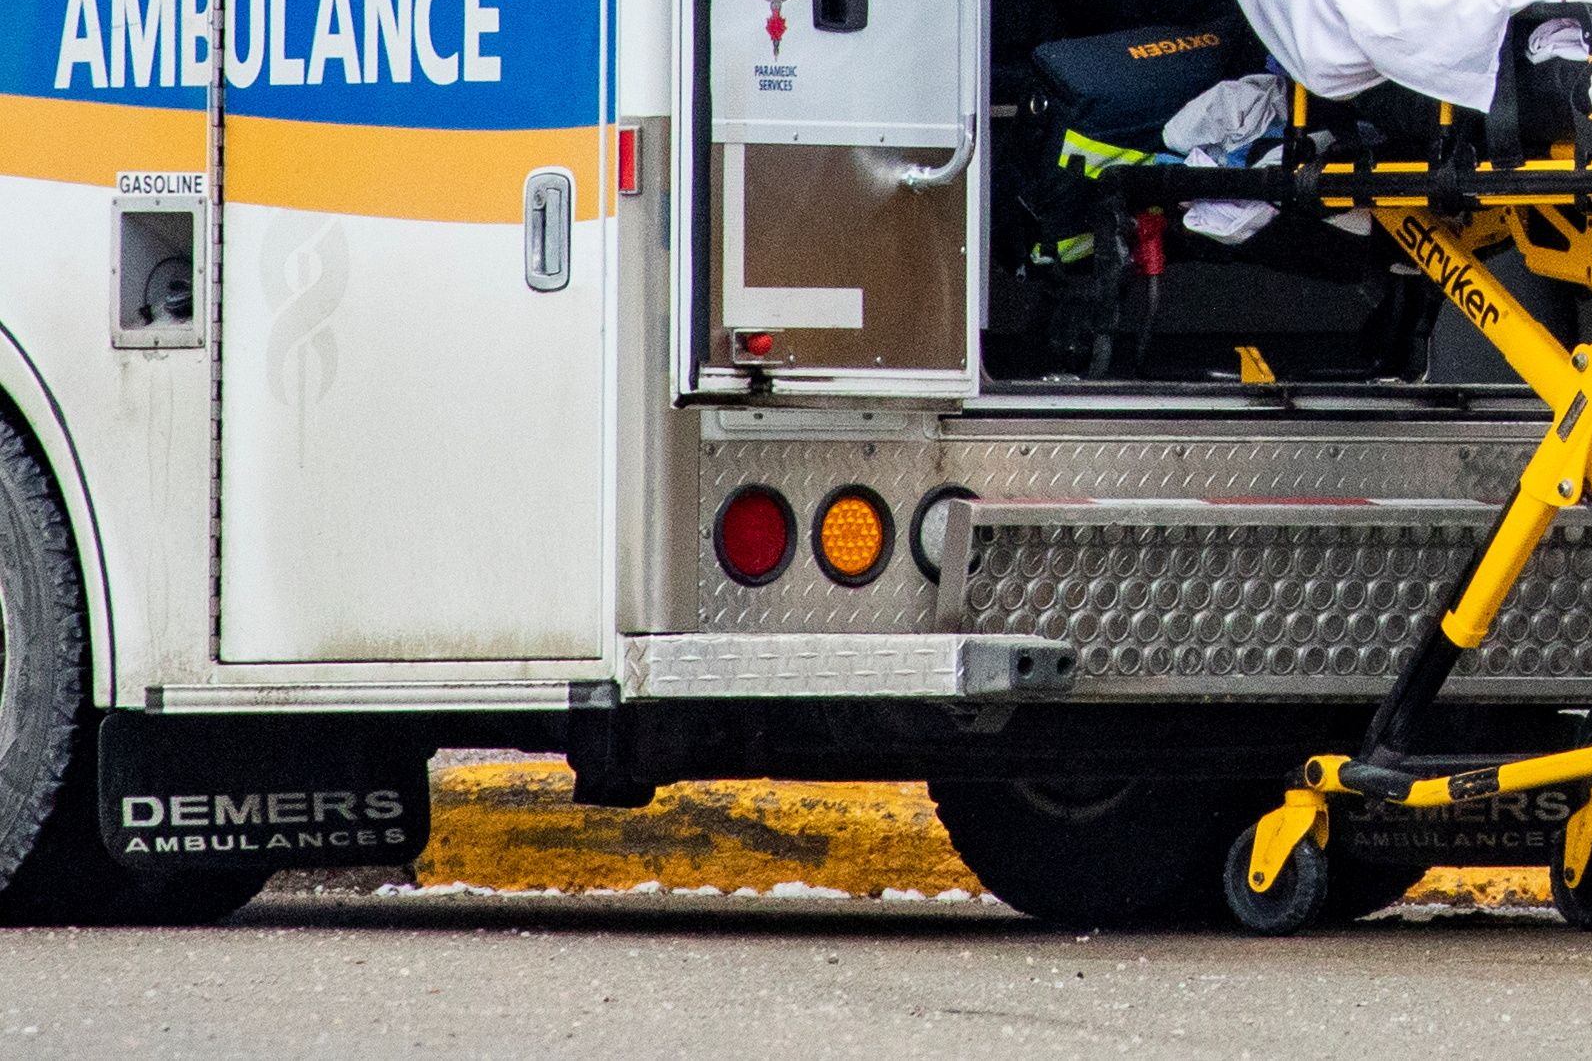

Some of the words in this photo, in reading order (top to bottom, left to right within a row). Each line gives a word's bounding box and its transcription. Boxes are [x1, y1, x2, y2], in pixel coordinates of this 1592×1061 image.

[1128, 34, 1219, 59] OXYGEN
[755, 66, 797, 77] PARAMEDIC
[758, 79, 793, 91] SERVICES
[120, 175, 203, 194] GASOLINE
[1396, 215, 1500, 330] stryker
[122, 790, 403, 827] DEMERS
[125, 828, 405, 853] AMBULANCES
